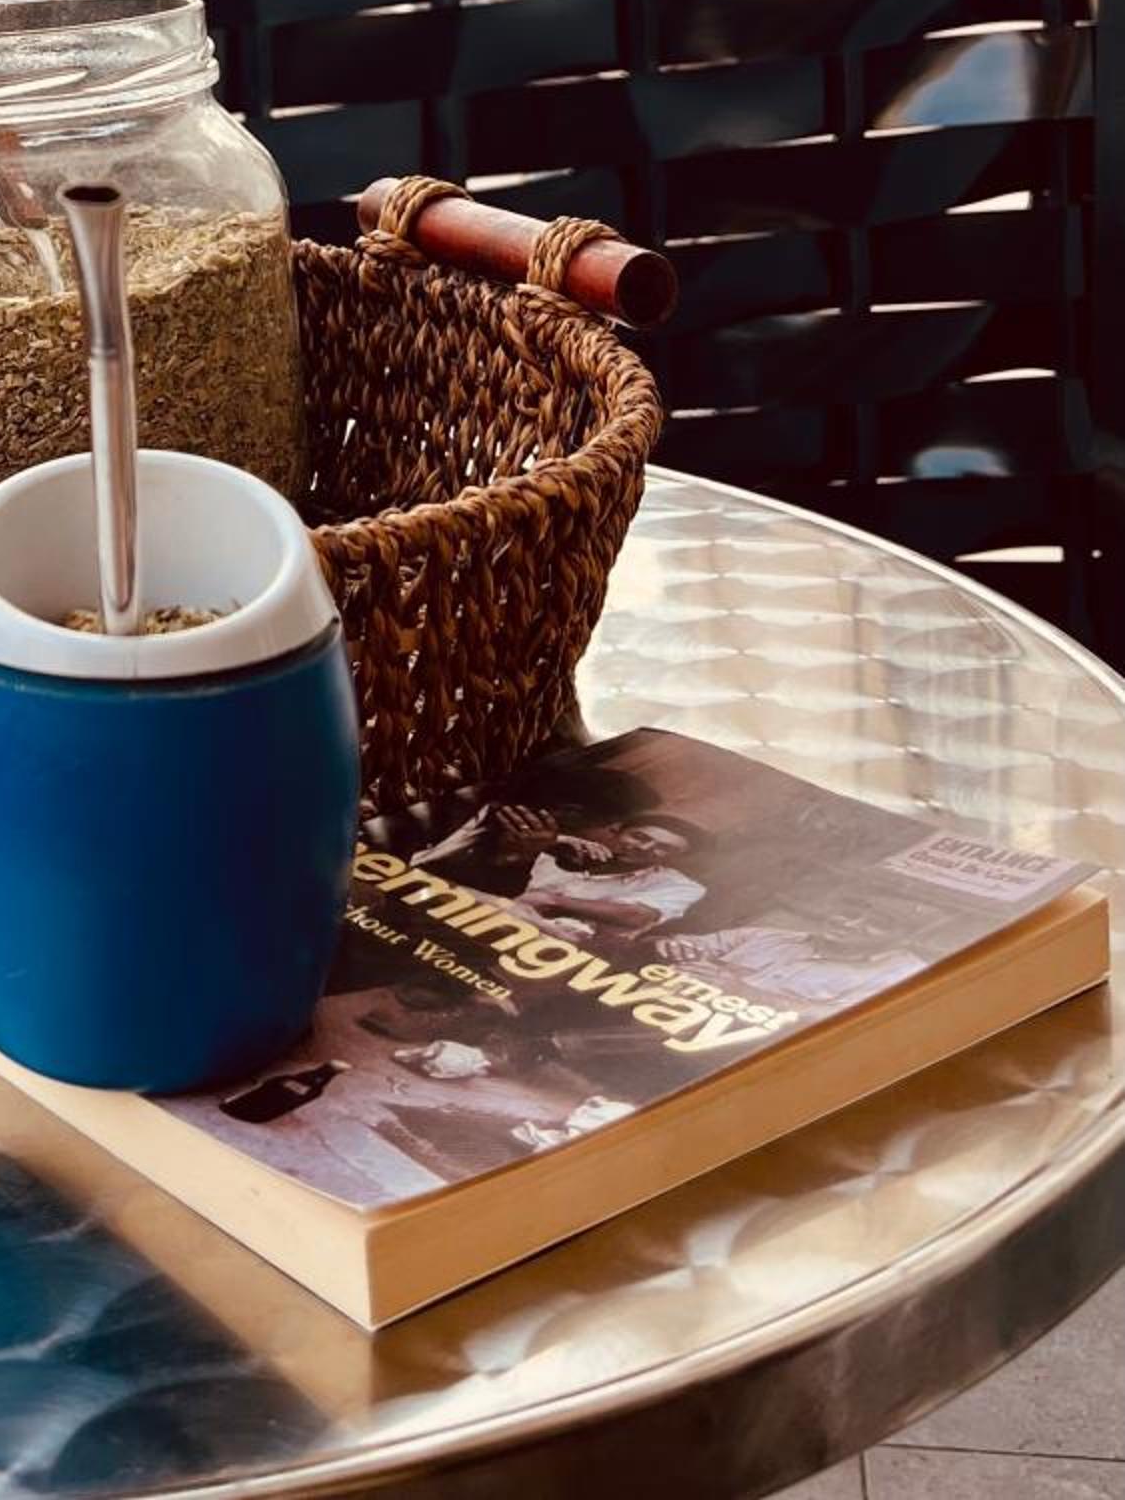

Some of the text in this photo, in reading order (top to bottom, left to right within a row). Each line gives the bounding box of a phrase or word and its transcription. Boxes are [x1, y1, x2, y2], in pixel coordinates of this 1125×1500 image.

[345, 900, 514, 1001] hout Women
[353, 842, 780, 1053] emingway
[638, 962, 799, 1032] ernest
